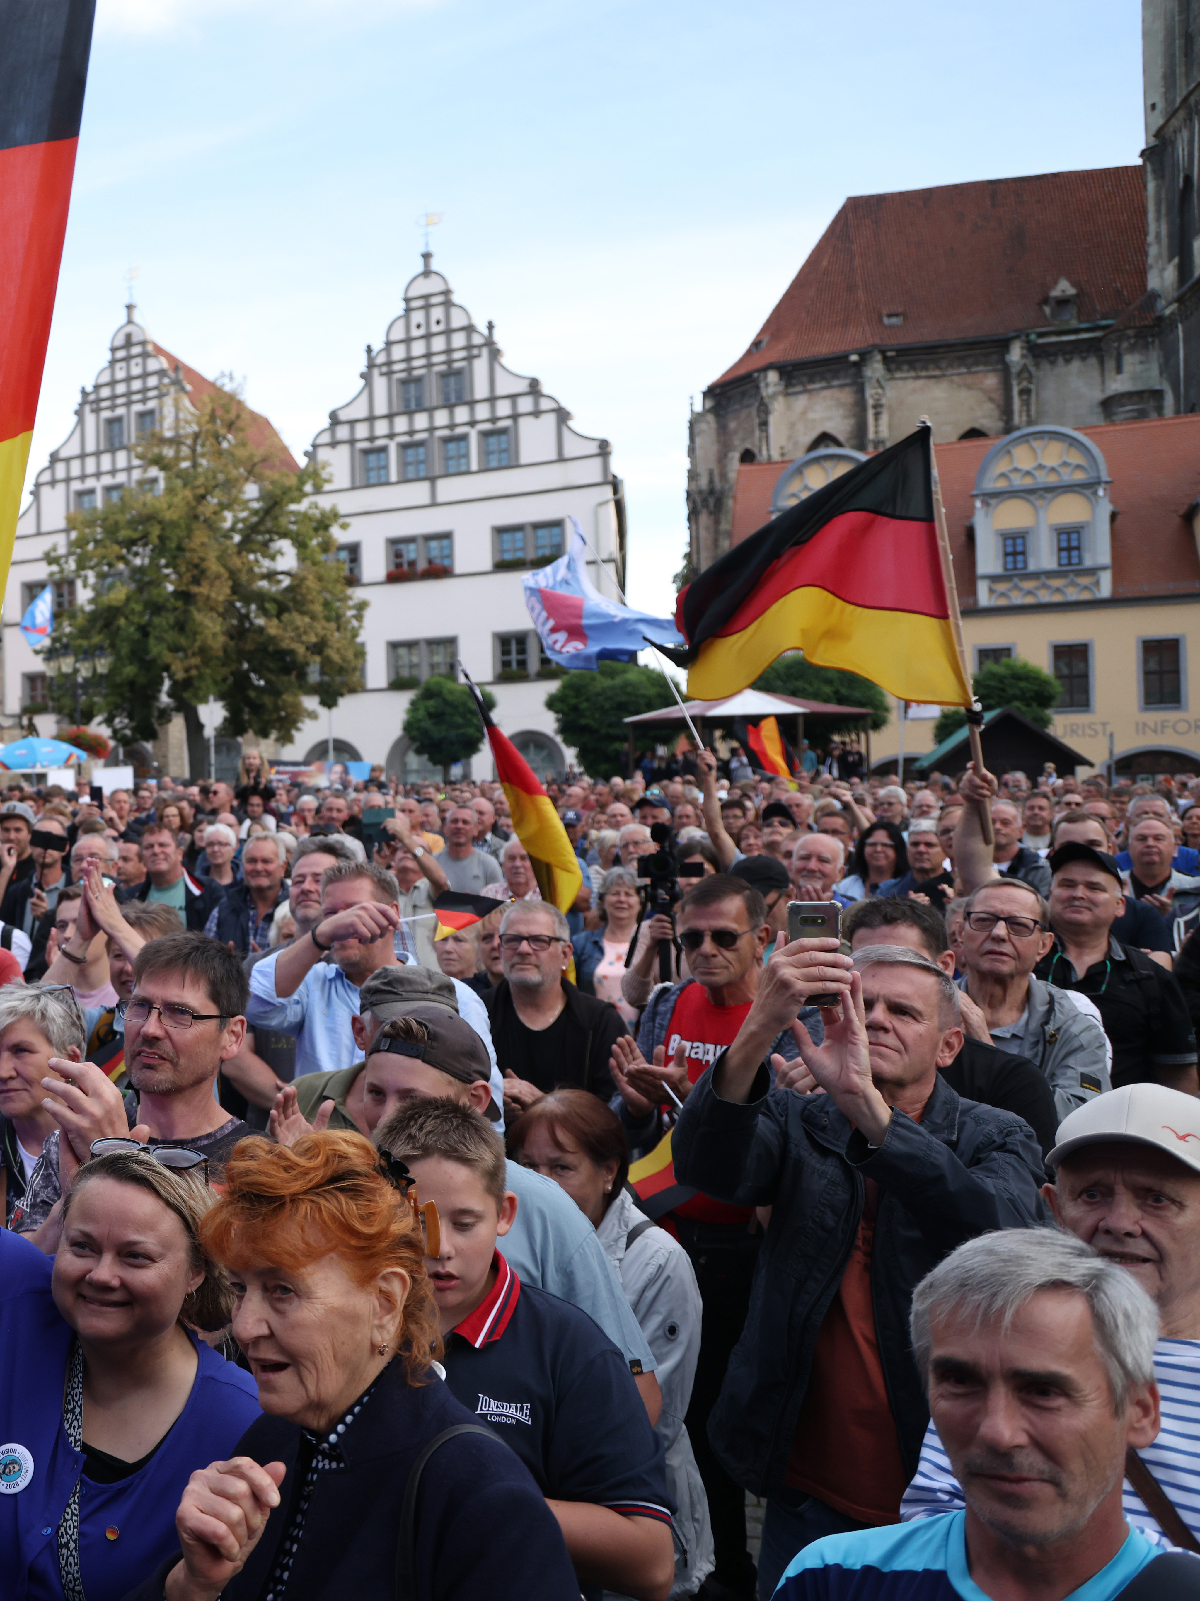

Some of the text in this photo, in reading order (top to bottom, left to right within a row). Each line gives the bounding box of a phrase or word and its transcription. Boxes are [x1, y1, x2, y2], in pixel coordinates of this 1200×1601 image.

[1052, 721, 1110, 739] URIST
[475, 1393, 532, 1425] LONSDALE
[487, 1413, 517, 1425] LONDON
